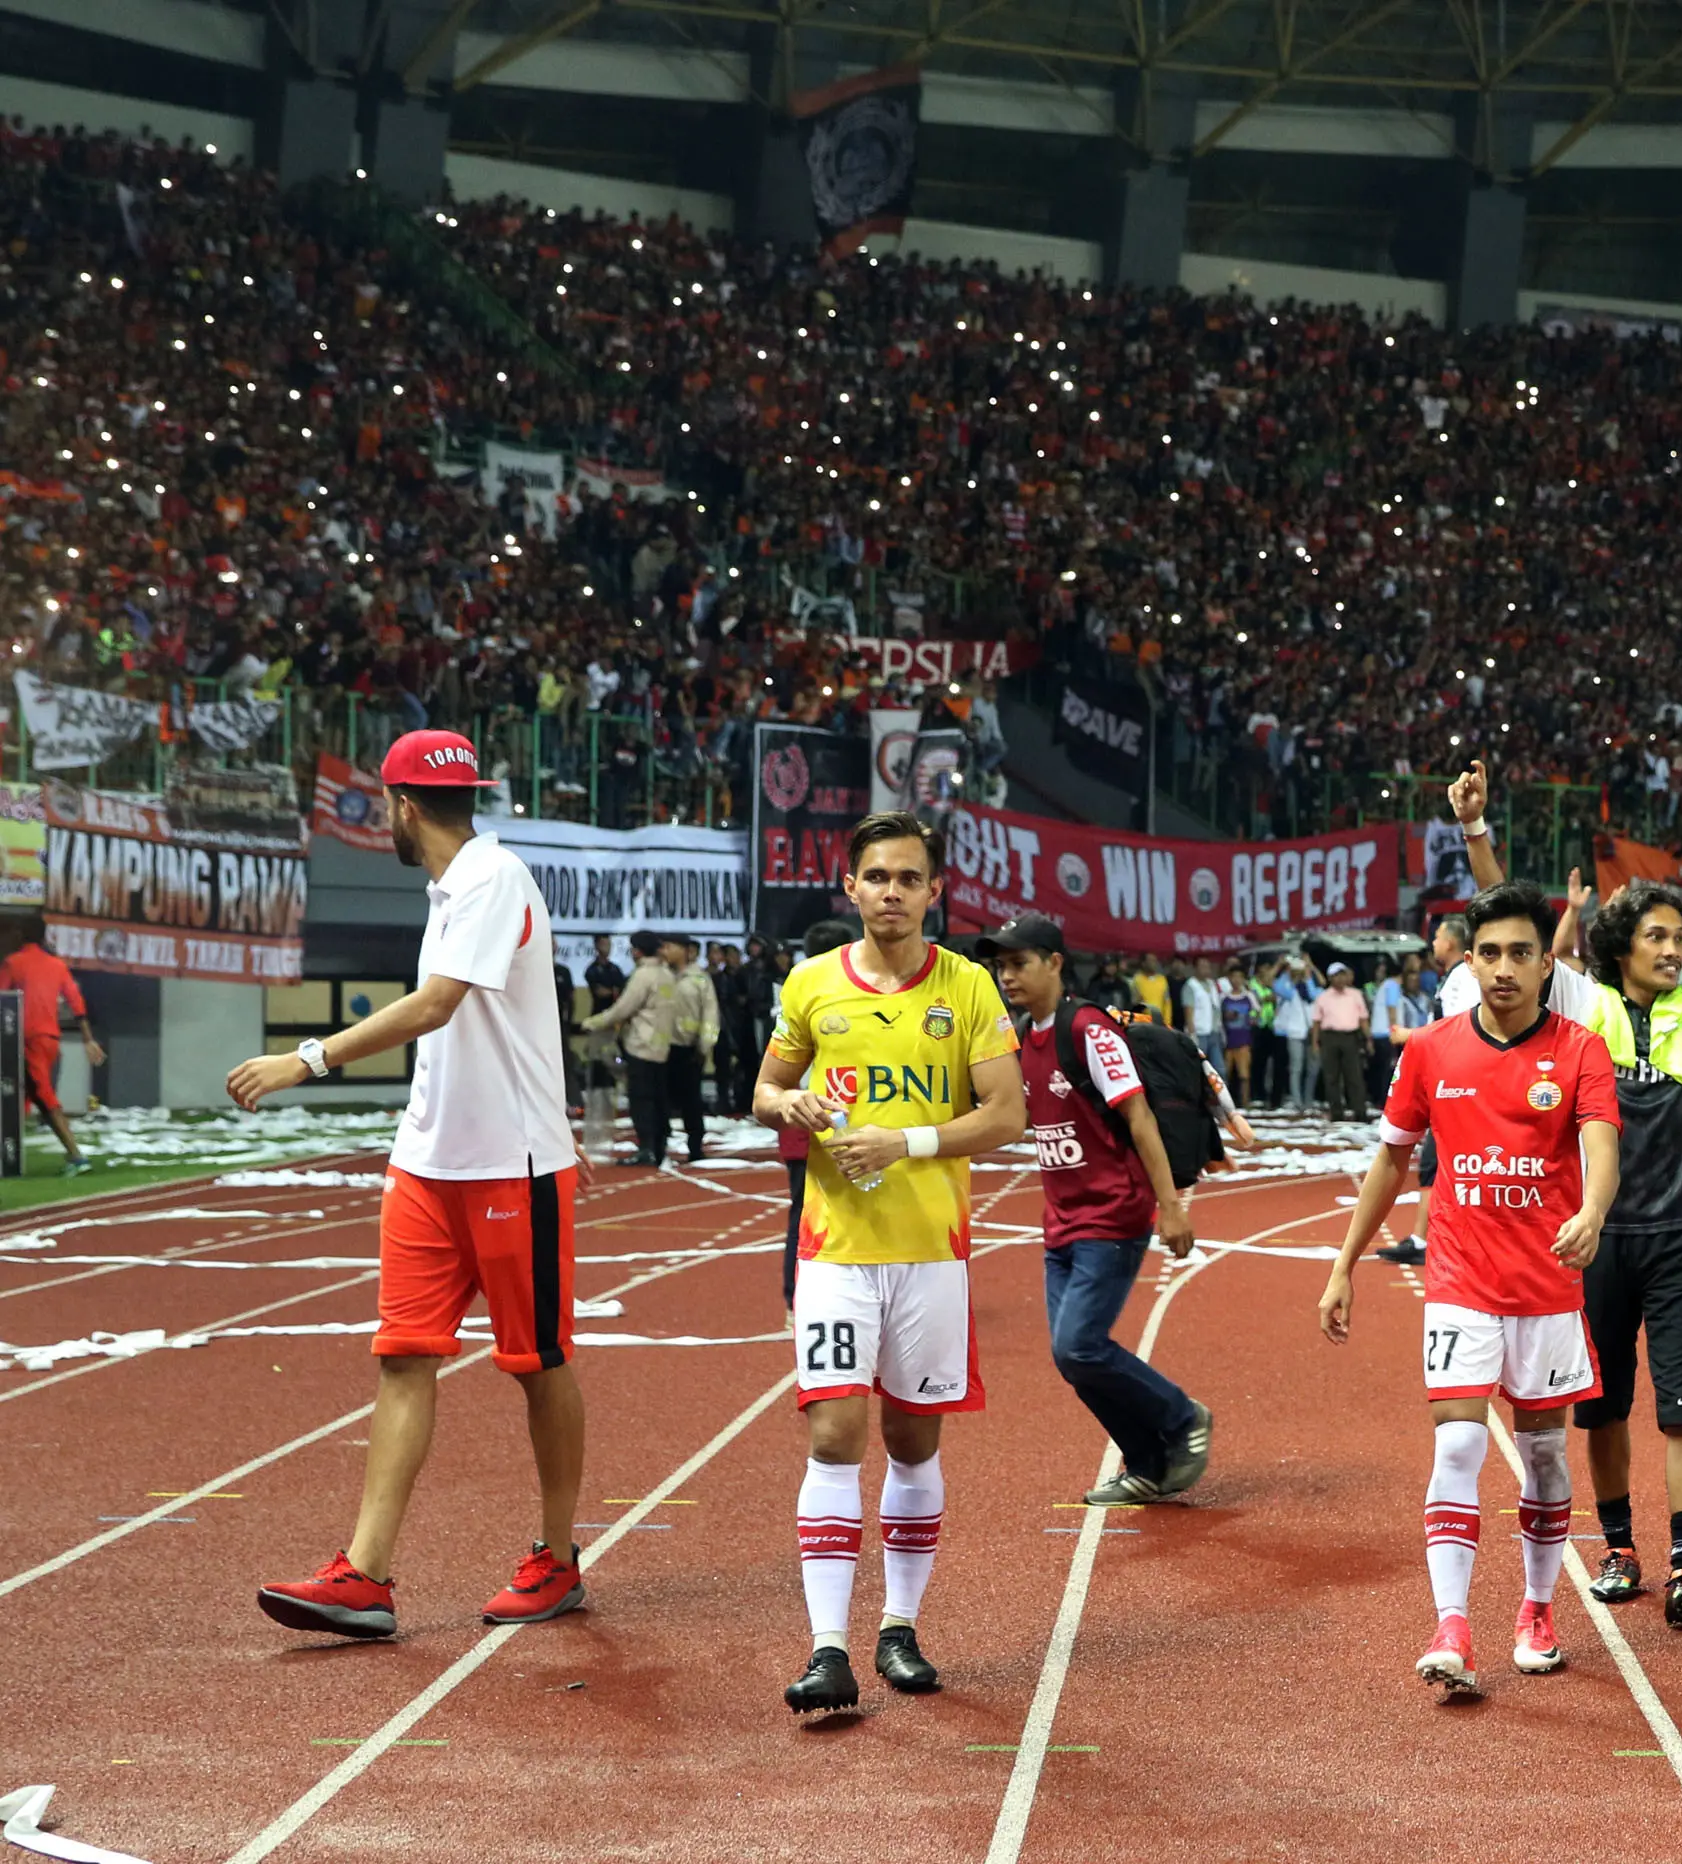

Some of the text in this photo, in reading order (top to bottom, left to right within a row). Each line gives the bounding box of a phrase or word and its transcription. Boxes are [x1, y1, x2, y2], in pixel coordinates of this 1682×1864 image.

[46, 827, 212, 928] KAMPUNG
[1101, 846, 1176, 925] WIN
[1232, 840, 1378, 926] REPEAT
[866, 1065, 951, 1103] BNI
[1487, 1184, 1543, 1208] TOA
[807, 1322, 857, 1370] 28
[1427, 1330, 1460, 1371] 27
